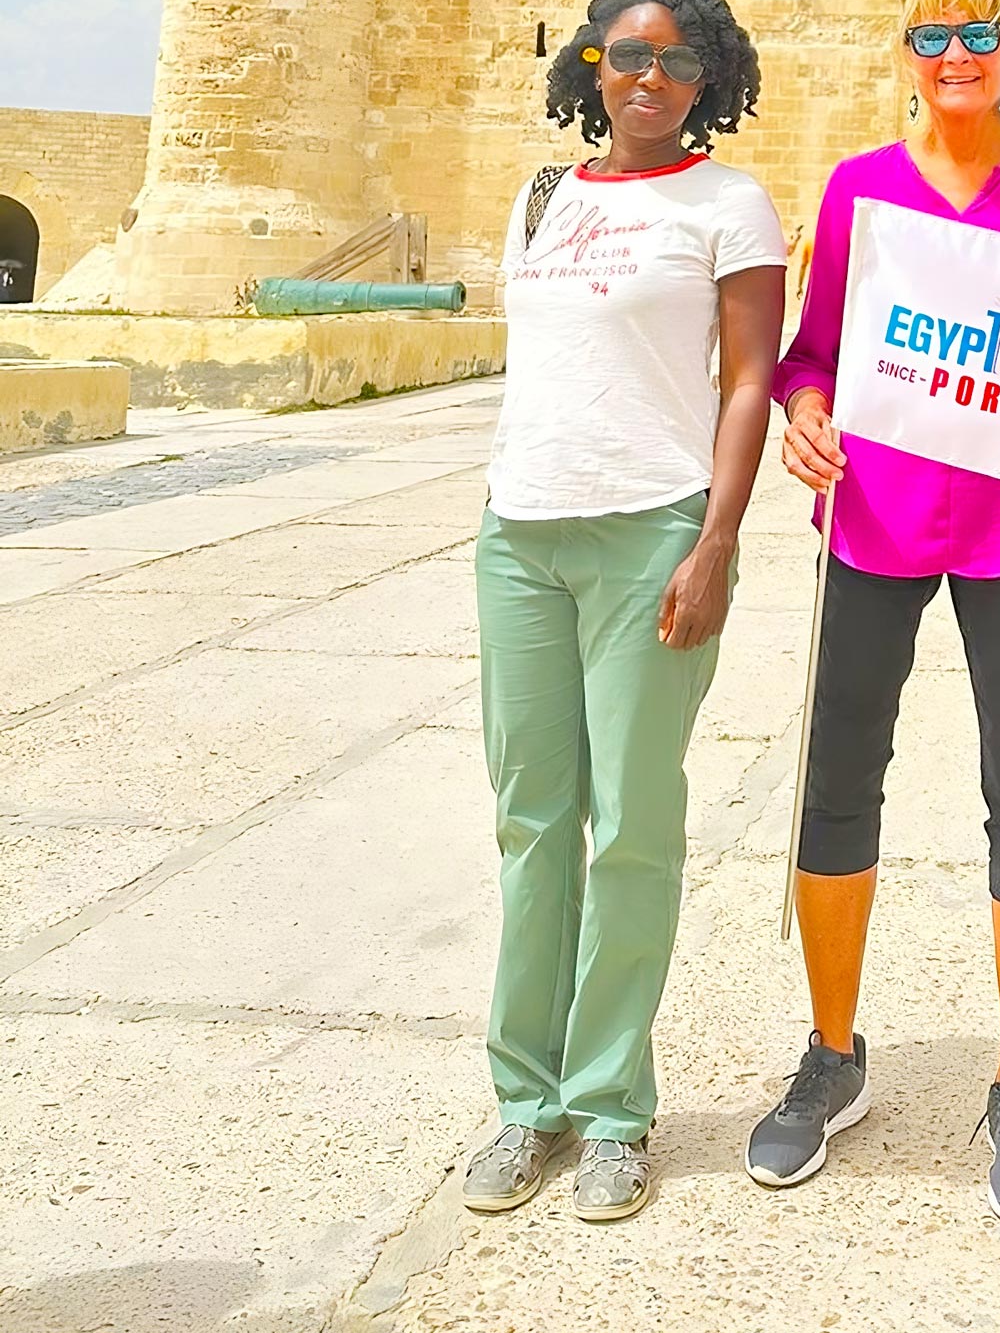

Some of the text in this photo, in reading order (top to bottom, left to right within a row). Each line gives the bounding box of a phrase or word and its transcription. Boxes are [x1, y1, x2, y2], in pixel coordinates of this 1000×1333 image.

[523, 199, 665, 264] California
[590, 246, 631, 260] CLUB
[512, 264, 638, 280] SAN FRANCISCO
